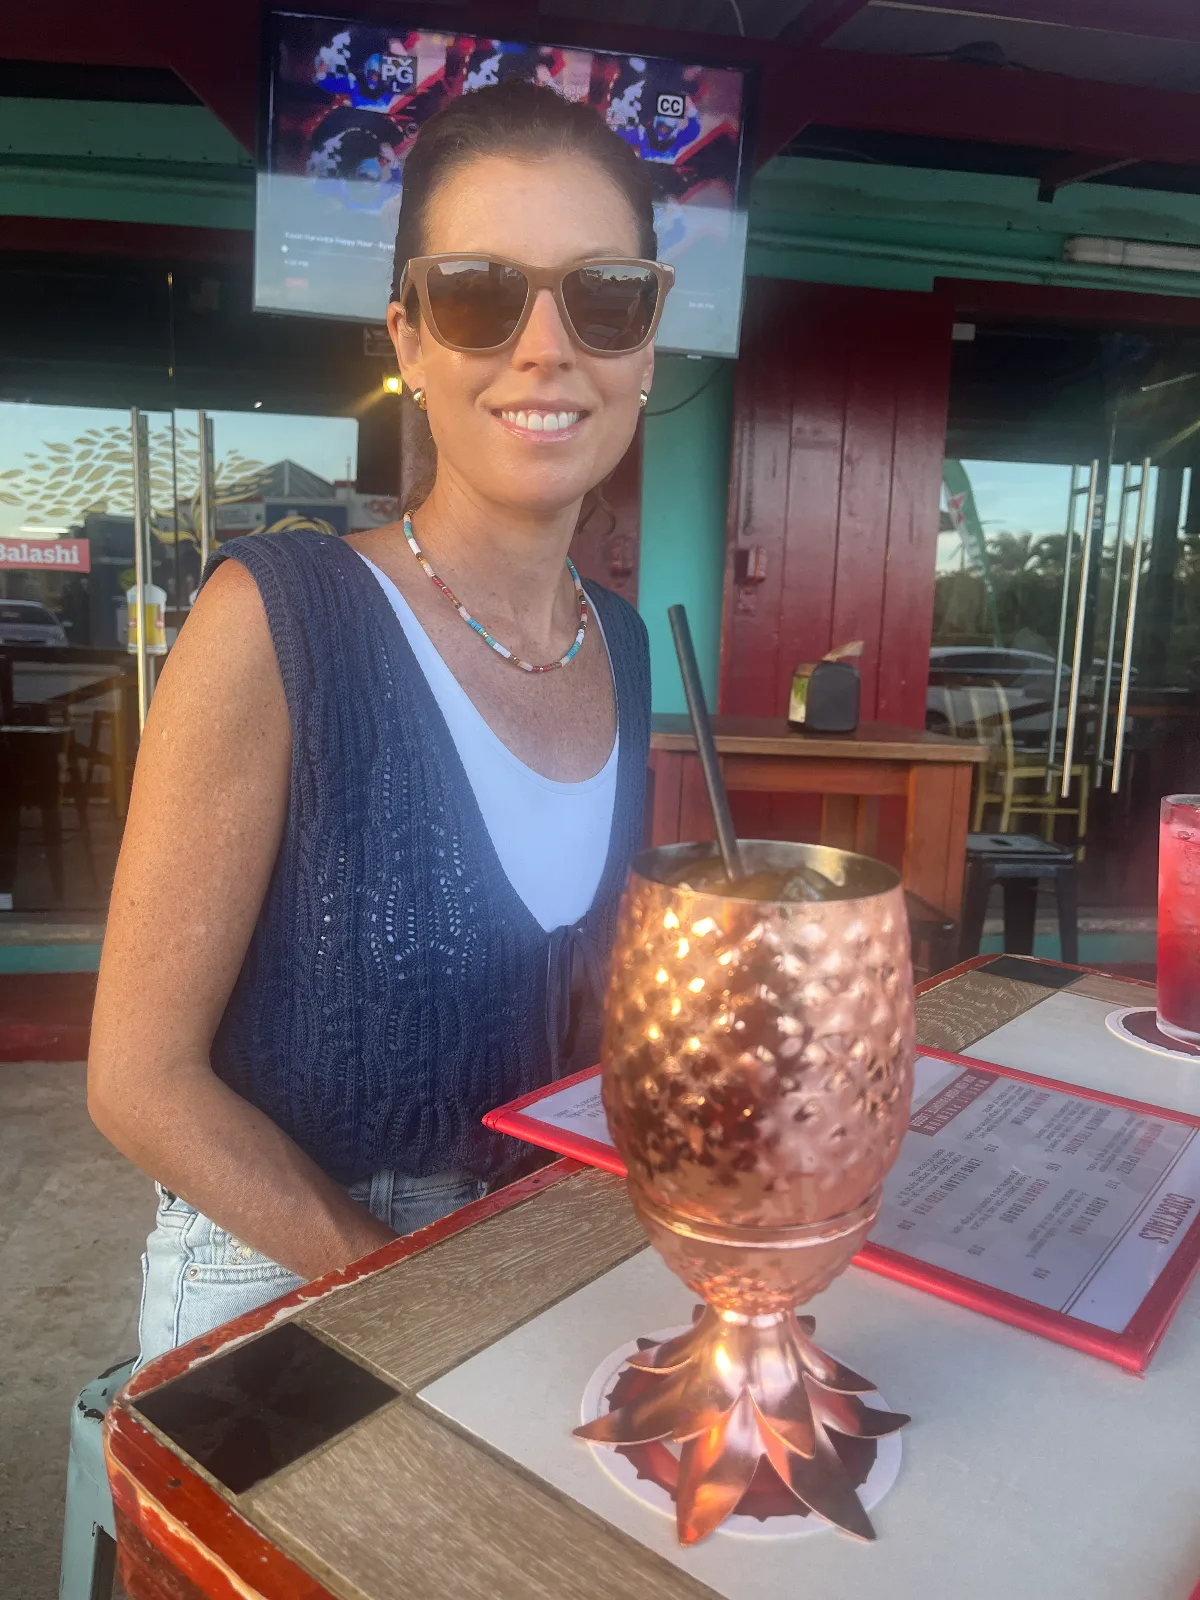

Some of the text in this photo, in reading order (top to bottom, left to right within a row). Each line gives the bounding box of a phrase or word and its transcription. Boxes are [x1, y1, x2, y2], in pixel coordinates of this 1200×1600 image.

[381, 63, 414, 83] PG
[660, 98, 680, 113] CC
[0, 543, 79, 564] Balashi
[961, 1157, 983, 1172] LONG
[940, 1170, 969, 1191] ISLAND
[1139, 1193, 1196, 1244] COCKTAILS
